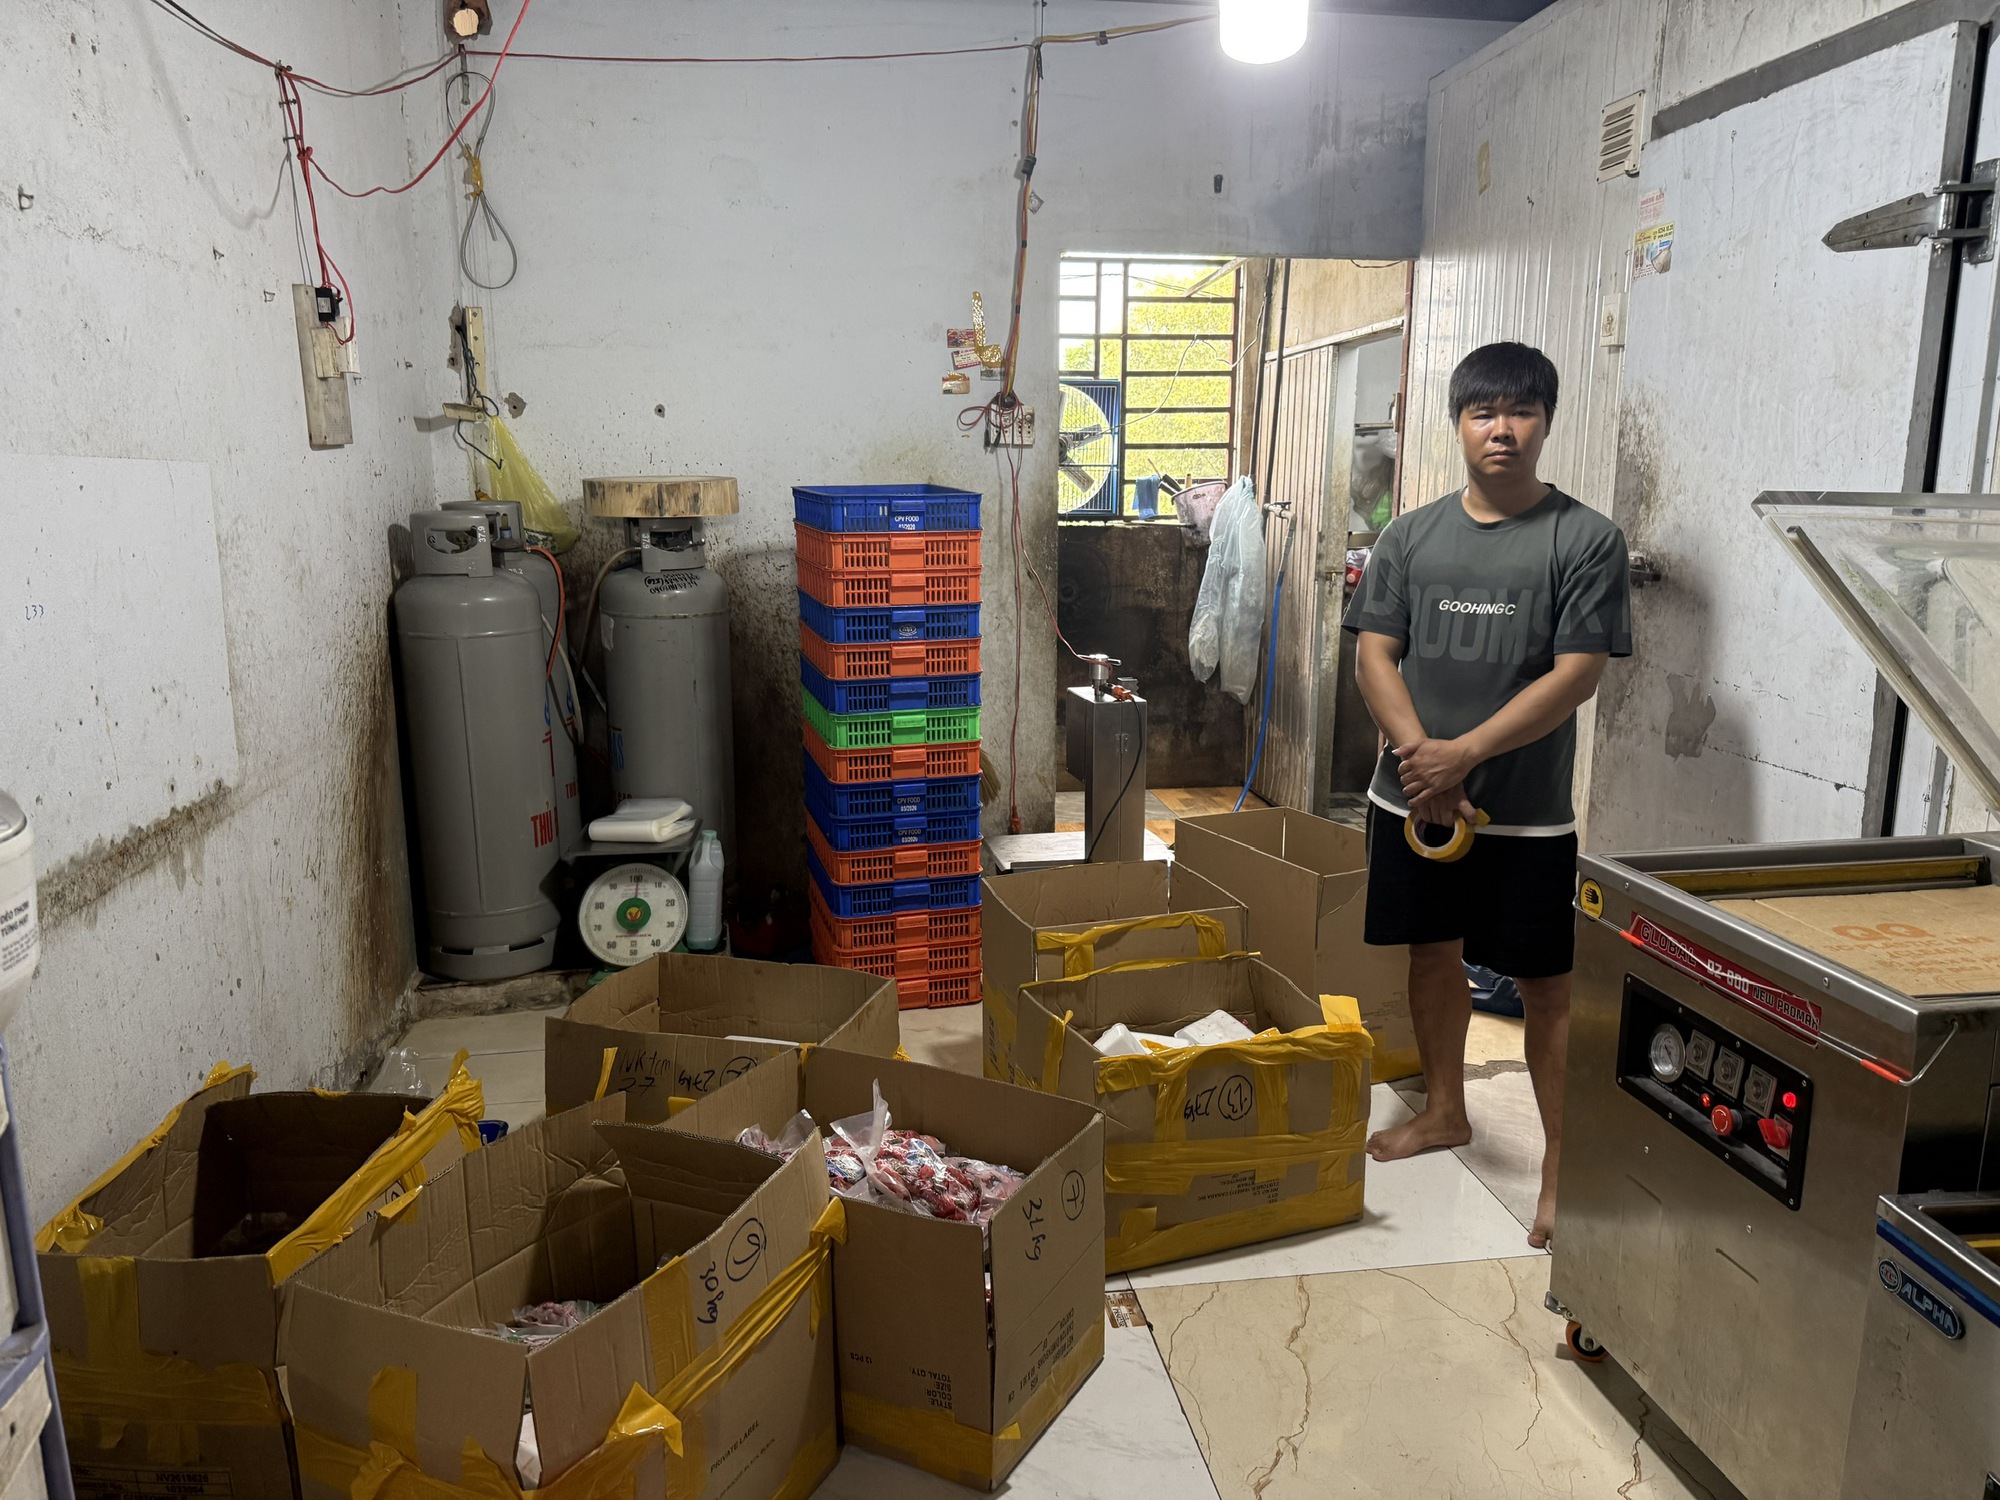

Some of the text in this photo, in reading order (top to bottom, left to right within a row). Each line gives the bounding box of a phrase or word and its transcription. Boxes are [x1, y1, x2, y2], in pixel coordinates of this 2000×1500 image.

[477, 525, 487, 543] 37.9
[642, 533, 651, 549] 37.9
[1438, 599, 1516, 616] GOOHINGC
[594, 899, 675, 910] 80 20
[1832, 923, 1936, 941] QQ
[607, 939, 661, 949] 60 40
[1640, 923, 1697, 967] GLOBAL
[1752, 986, 1774, 1007] NEW
[1776, 998, 1820, 1031] PROMAX
[618, 1077, 658, 1096] 27
[1901, 1282, 1955, 1335] ALPHA
[850, 1352, 873, 1364] 12 PCS
[928, 1371, 952, 1382] TOTAL
[710, 1441, 739, 1474] PRIVATE
[739, 1420, 760, 1445] LABEL
